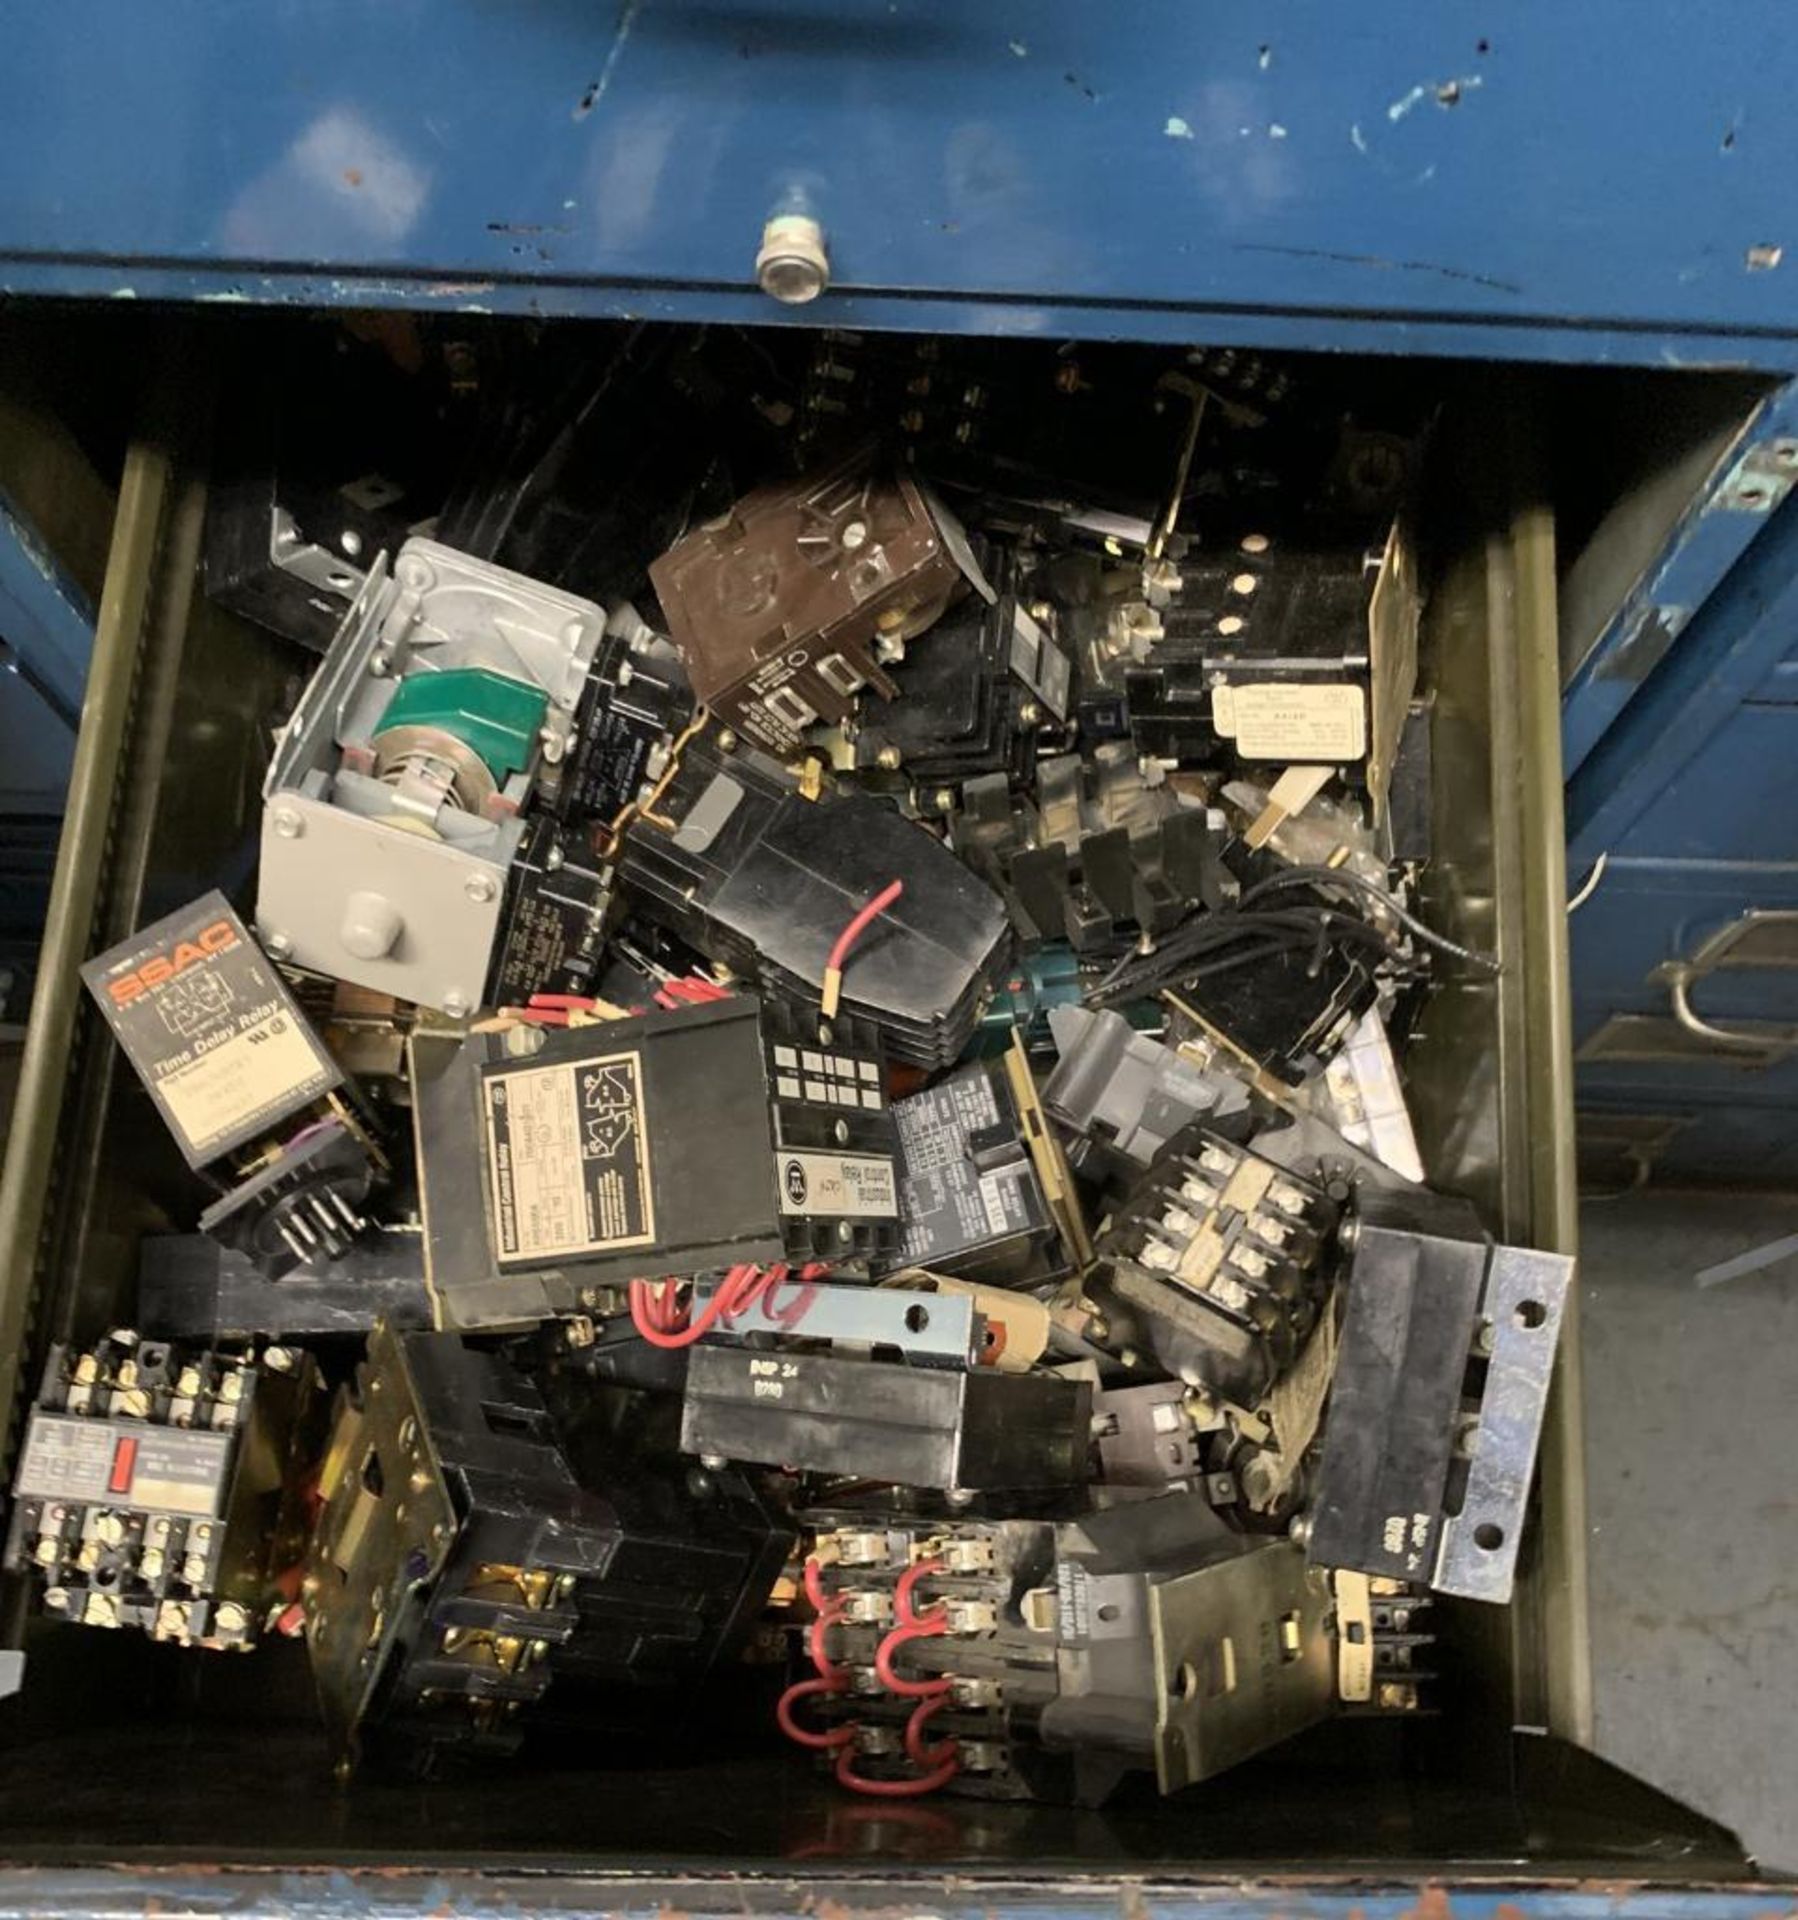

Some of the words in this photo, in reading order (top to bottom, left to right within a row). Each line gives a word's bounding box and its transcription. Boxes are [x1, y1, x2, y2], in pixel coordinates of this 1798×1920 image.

[106, 919, 238, 1006] SSAC
[153, 1048, 192, 1076] Time
[192, 1023, 236, 1054] Delay
[238, 998, 279, 1028] Relay
[498, 1142, 508, 1169] Relay
[840, 1161, 861, 1181] Relay
[500, 1170, 511, 1204] Control
[863, 1166, 889, 1184] Control
[502, 1205, 515, 1250] Industrial
